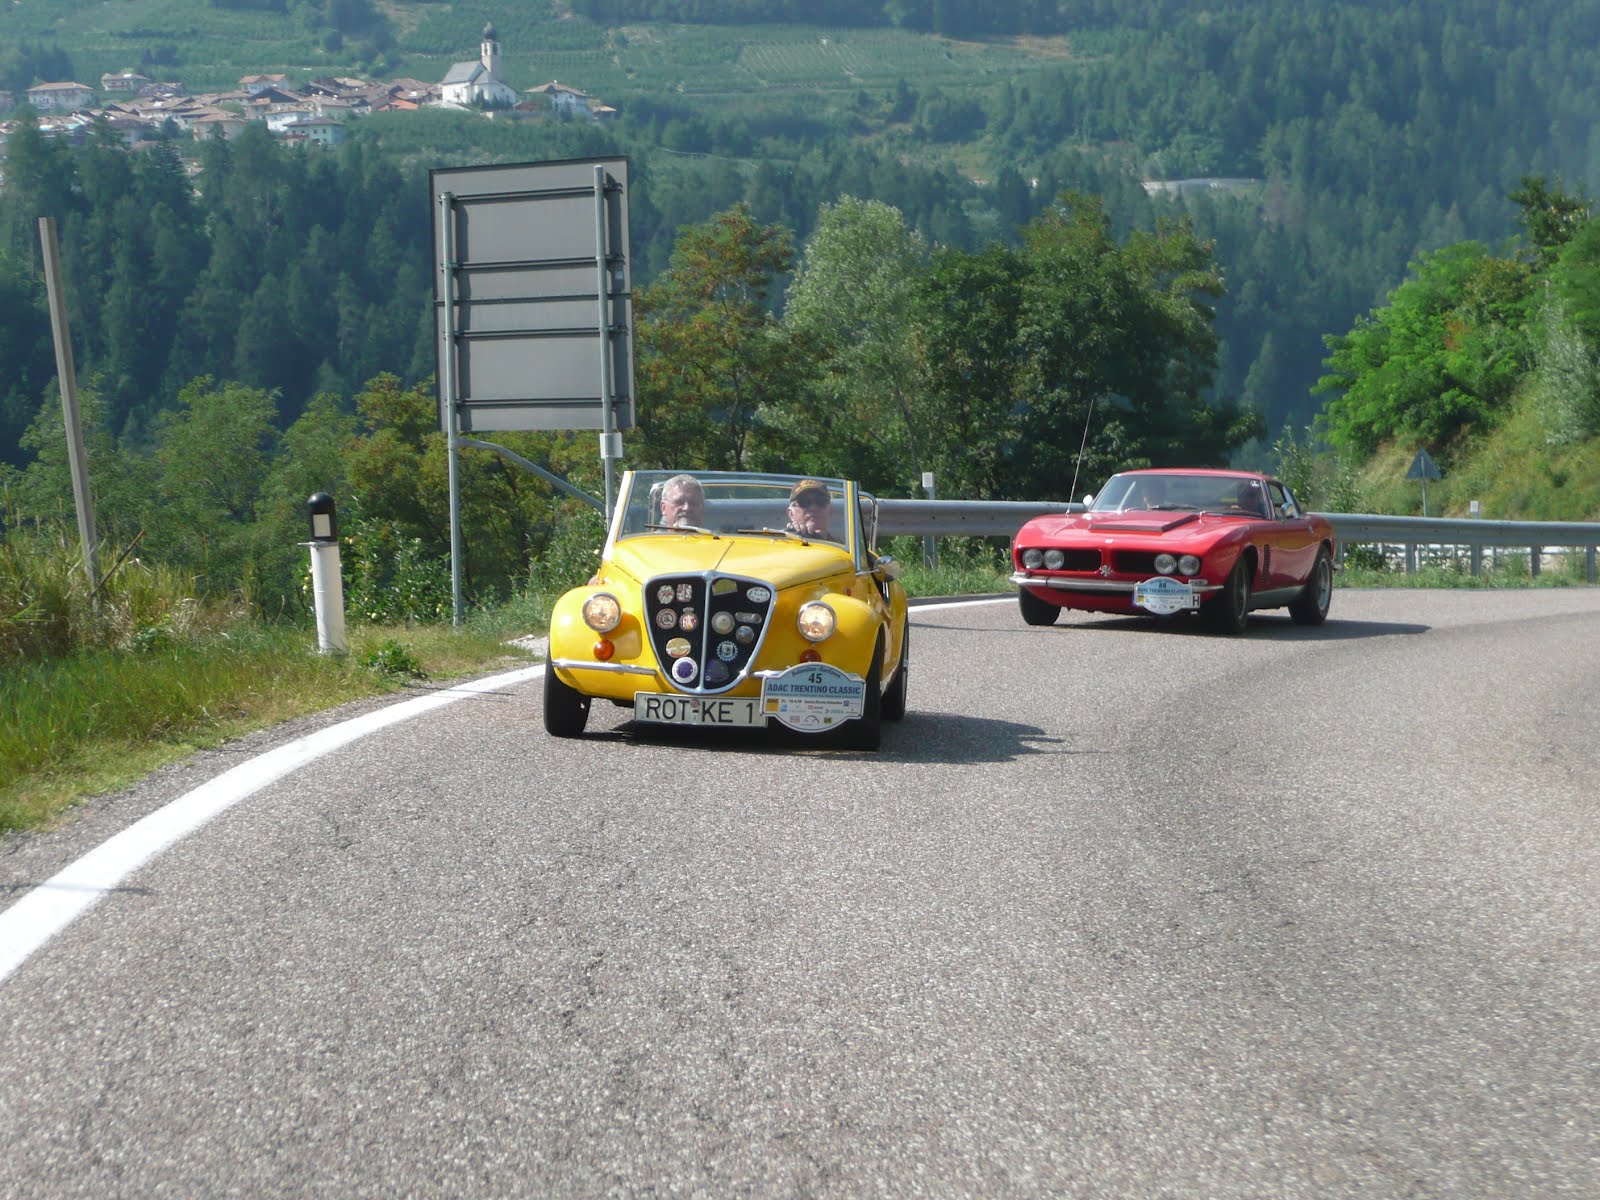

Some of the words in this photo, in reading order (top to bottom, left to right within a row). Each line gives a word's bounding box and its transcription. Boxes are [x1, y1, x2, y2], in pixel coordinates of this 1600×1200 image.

[1192, 595, 1200, 607] H
[808, 673, 822, 684] 45
[767, 684, 790, 692] ADAC
[790, 685, 828, 693] TRENTINO
[829, 686, 861, 695] CLASSIC
[745, 702, 753, 724] 1
